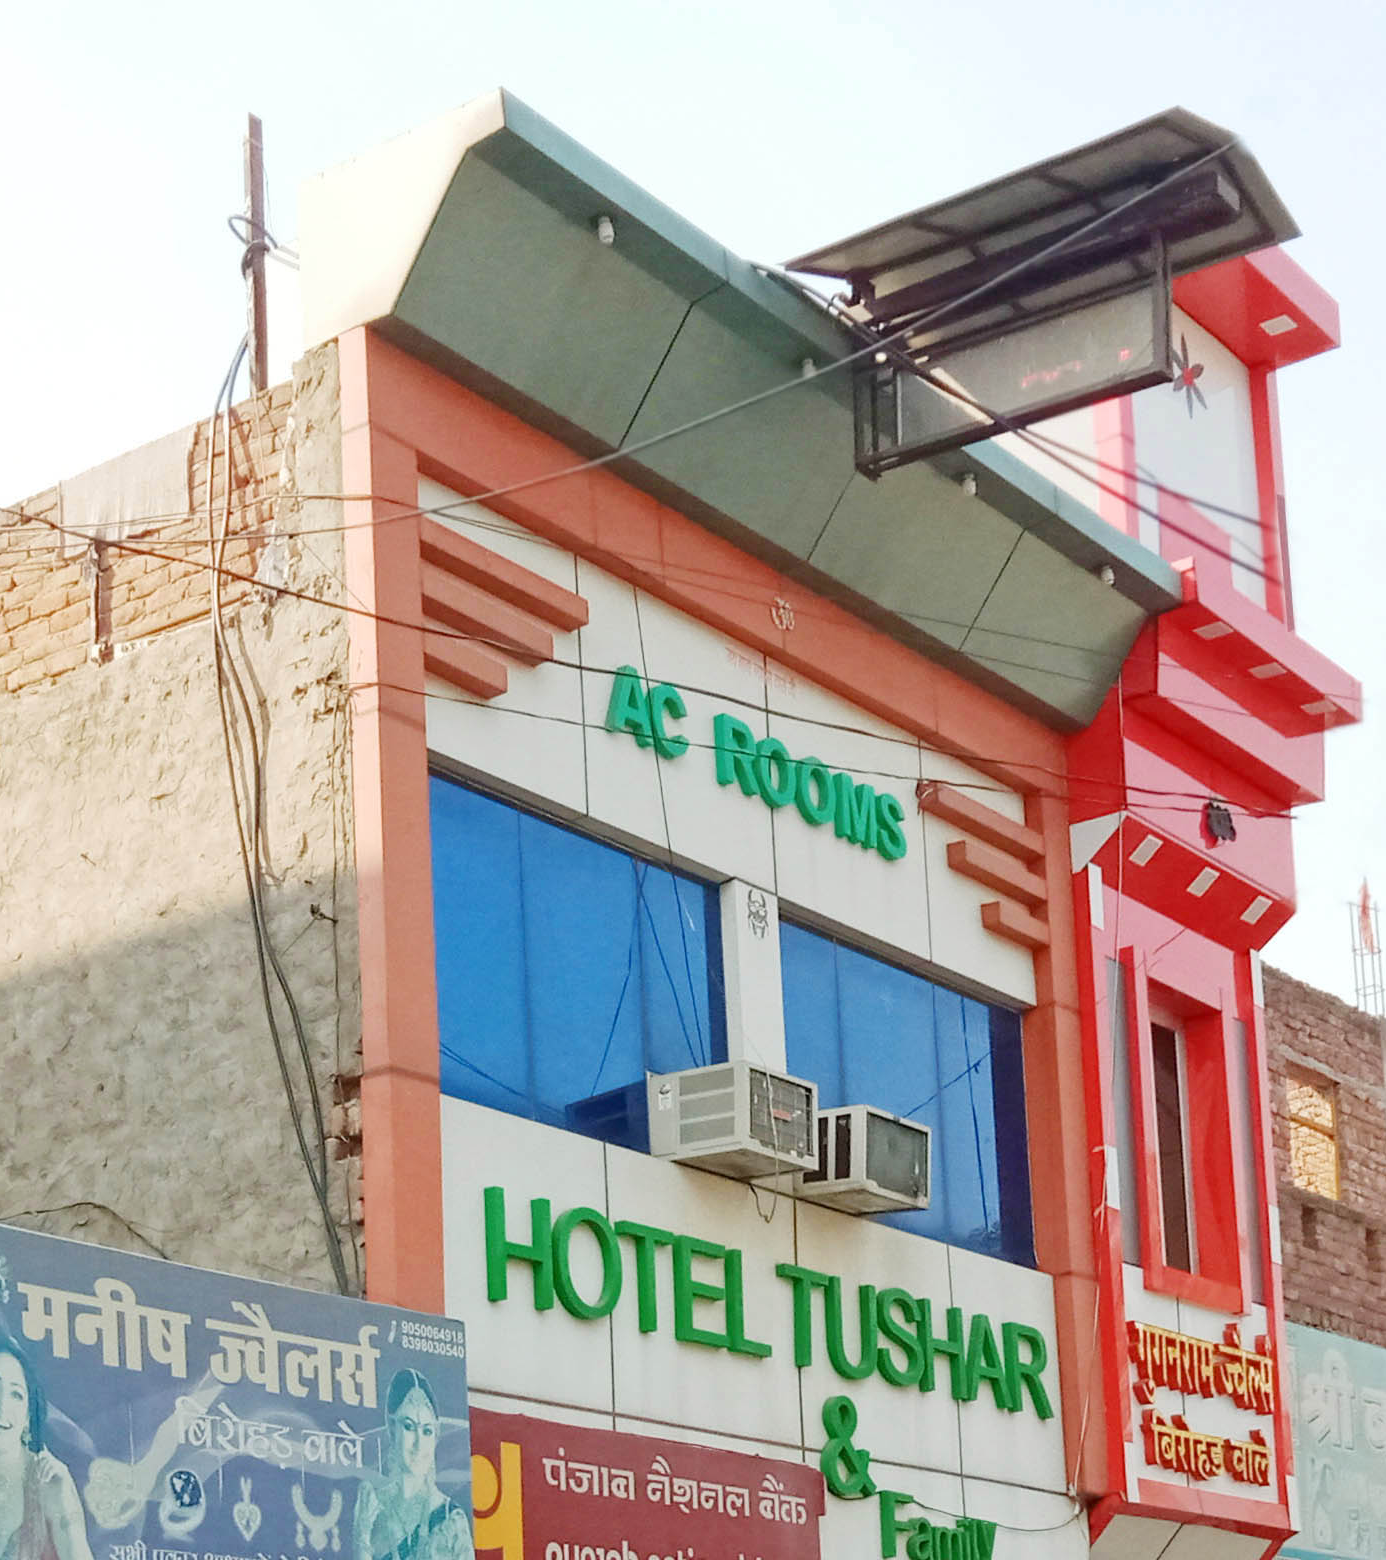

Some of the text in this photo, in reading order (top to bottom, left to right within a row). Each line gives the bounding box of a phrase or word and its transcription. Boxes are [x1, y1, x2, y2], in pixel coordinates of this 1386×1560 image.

[604, 664, 689, 760] AC
[713, 713, 907, 861] ROOMS
[16, 1279, 382, 1409] मनीष ज्वैलर्स
[401, 1319, 465, 1345] 9050064918
[401, 1335, 466, 1361] 8398030540
[483, 1186, 1055, 1421] HOTEL TUSHAR
[303, 1421, 364, 1469] वाले
[542, 1447, 808, 1527] पंजाब नैशनल बैंक
[819, 1395, 877, 1498] &
